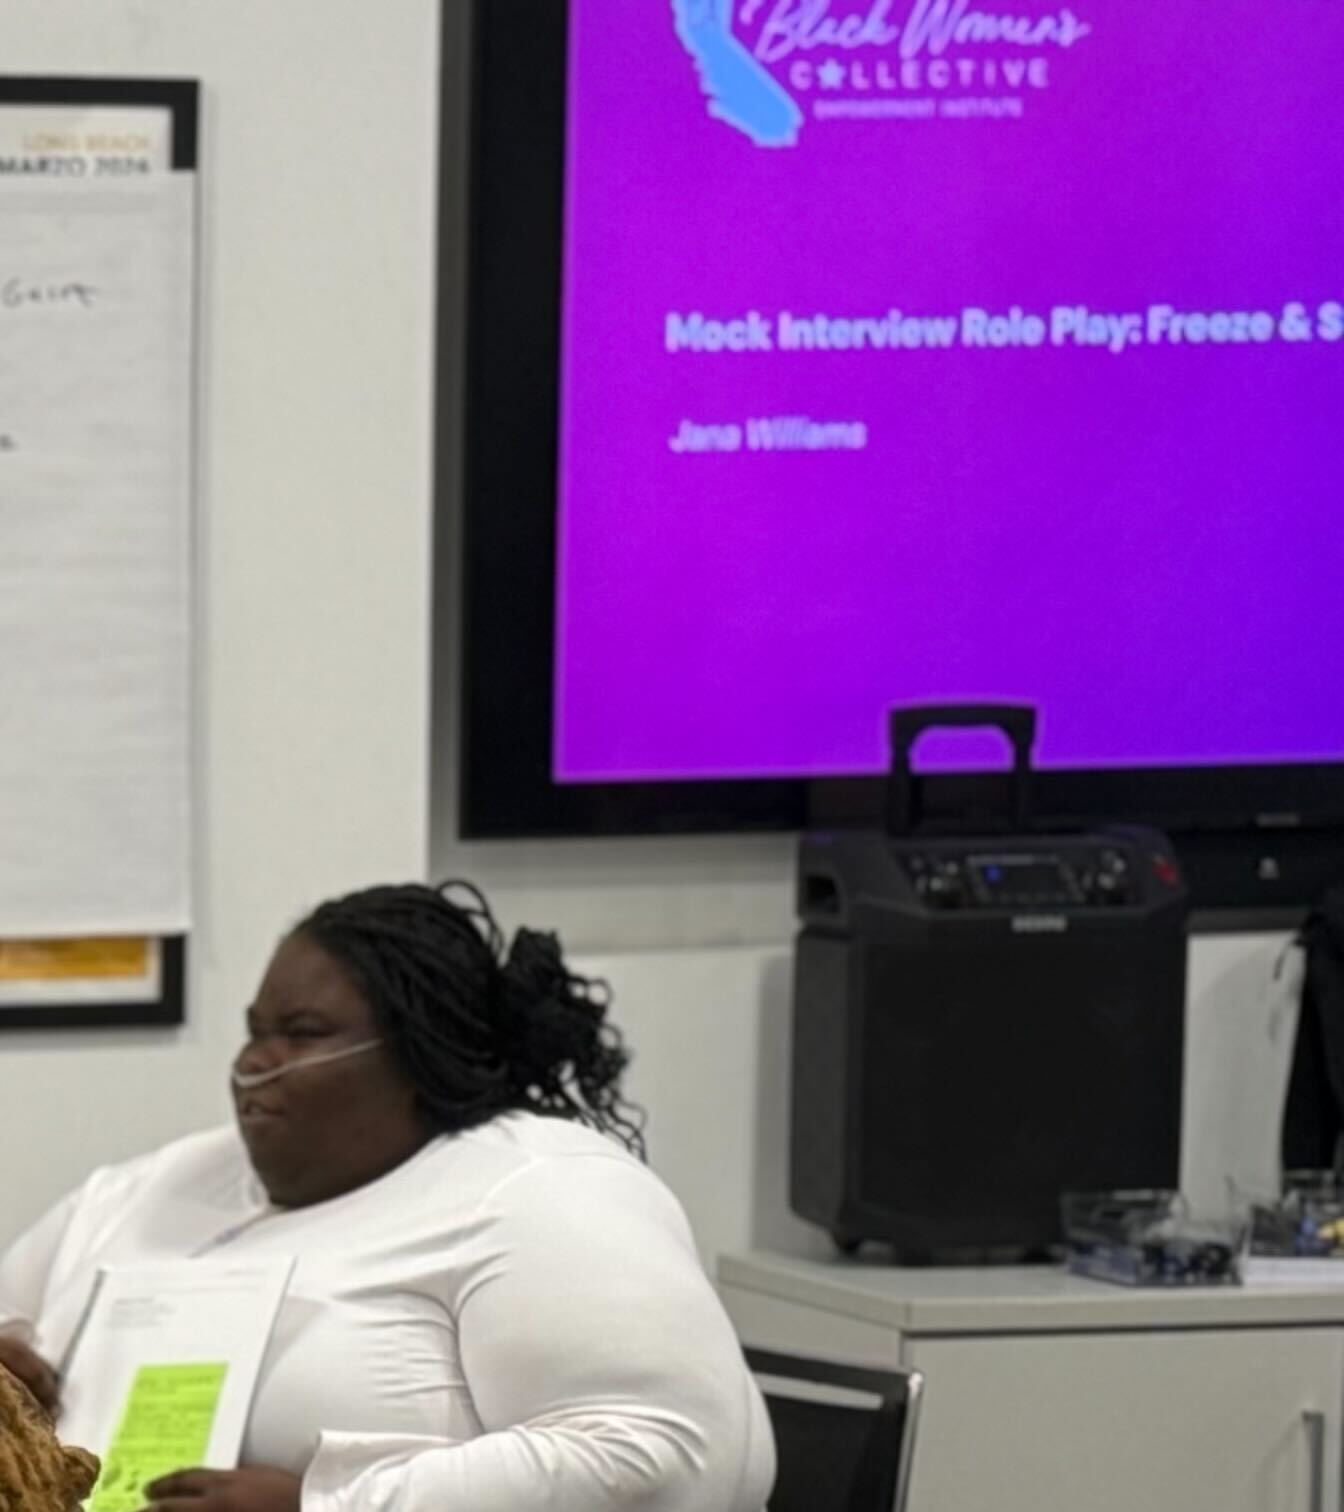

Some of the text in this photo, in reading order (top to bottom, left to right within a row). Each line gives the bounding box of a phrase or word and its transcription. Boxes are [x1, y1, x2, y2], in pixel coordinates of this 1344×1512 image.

[665, 310, 773, 352] Mock
[777, 307, 958, 351] Interview
[961, 306, 1046, 348] Role
[1050, 304, 1143, 354] Play:
[1146, 303, 1274, 345] Freeze
[1278, 301, 1313, 342] &
[745, 415, 869, 451] Williams
